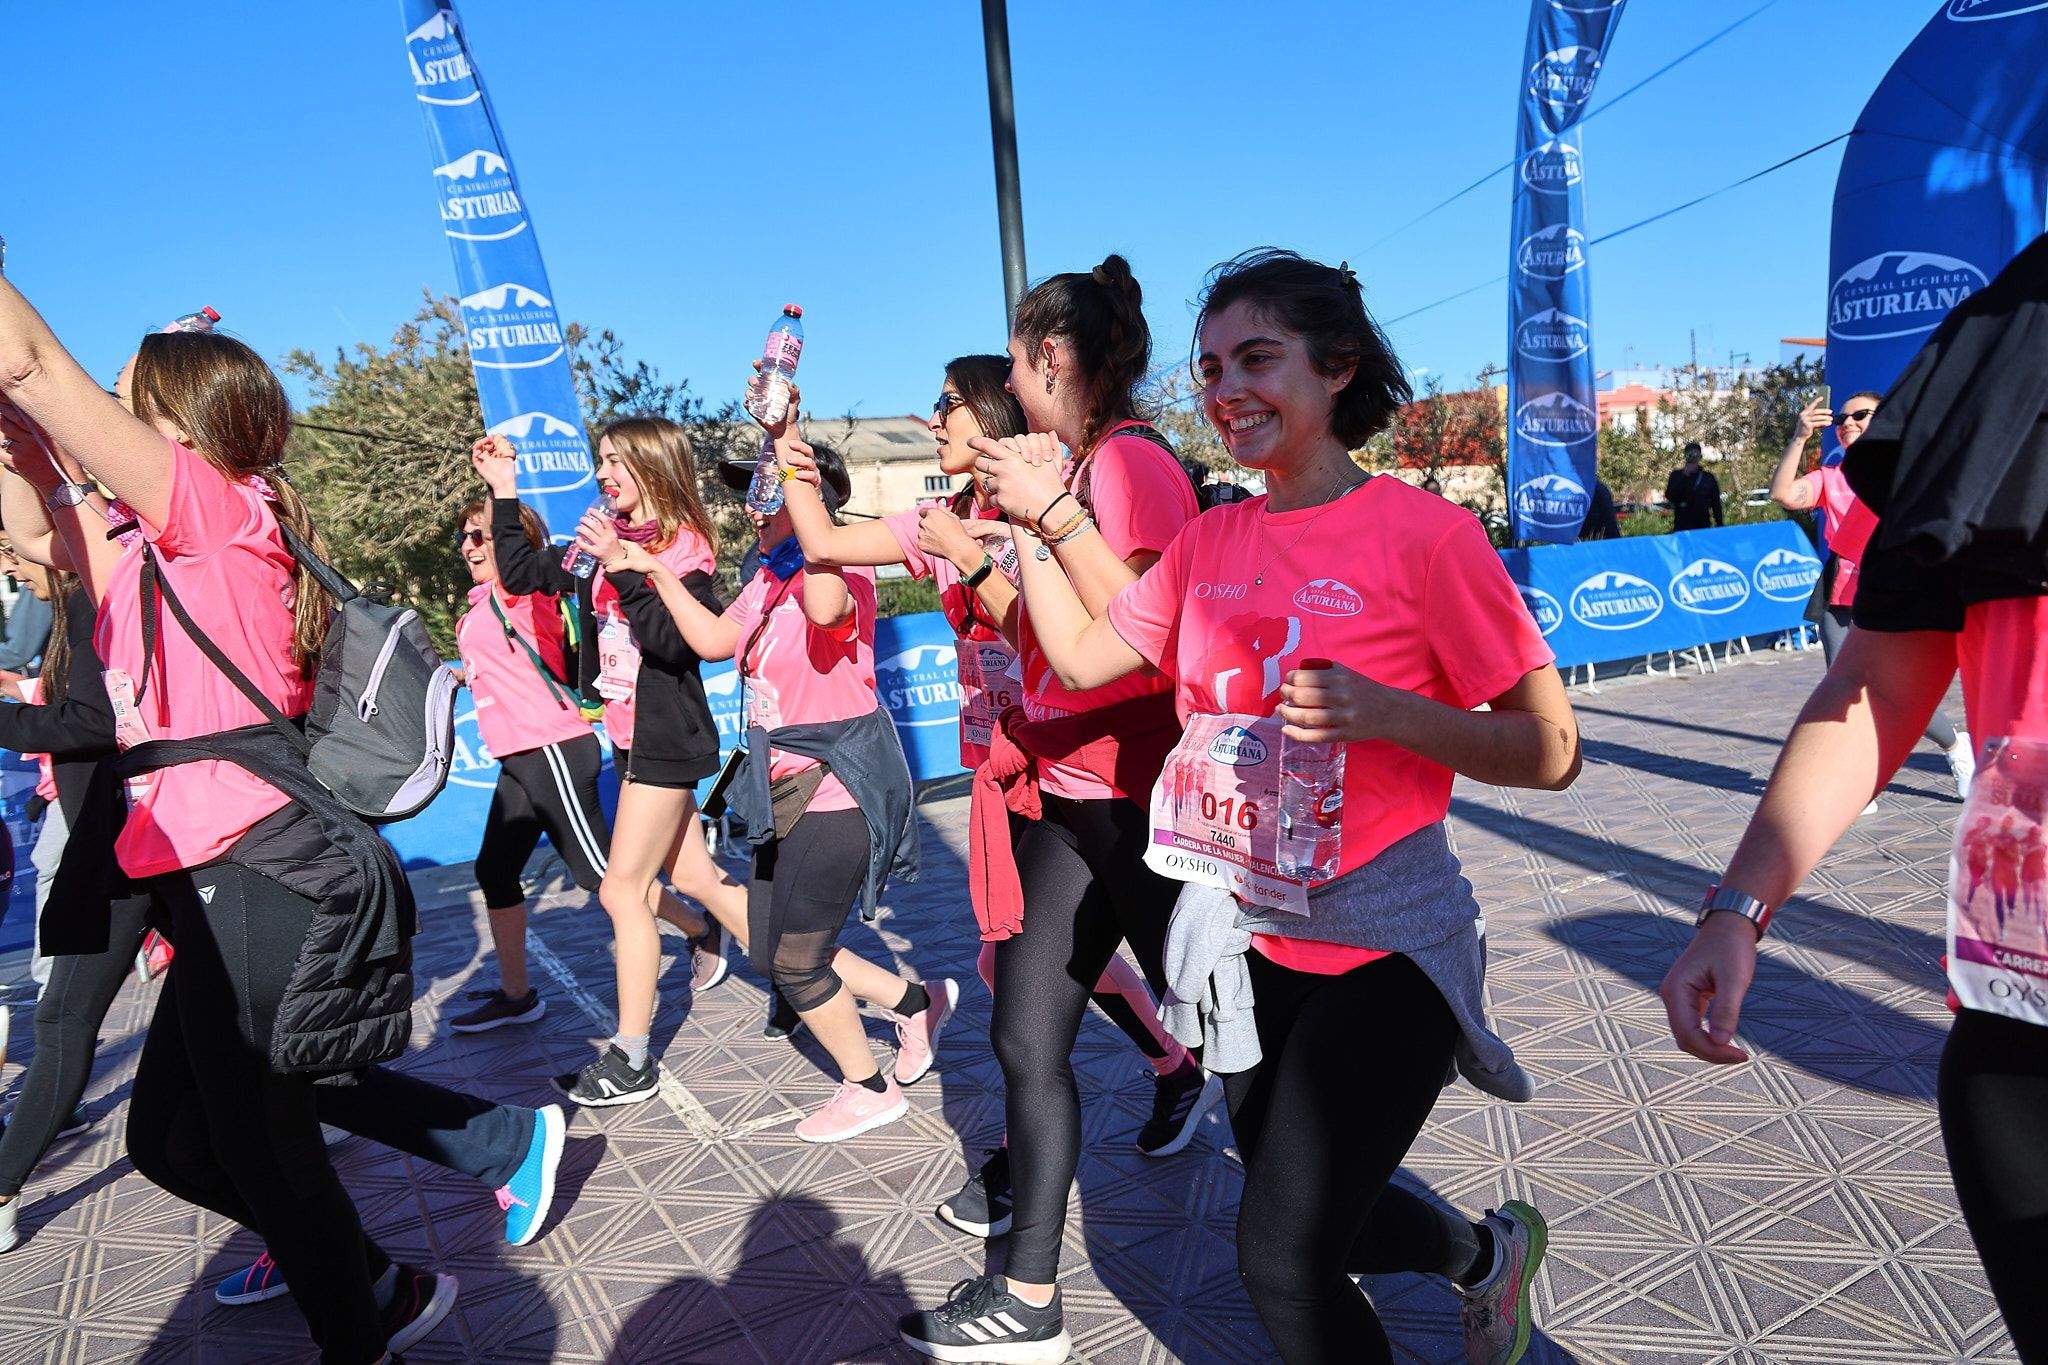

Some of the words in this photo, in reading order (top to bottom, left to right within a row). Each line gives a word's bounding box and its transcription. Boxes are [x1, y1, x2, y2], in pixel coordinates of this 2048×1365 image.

[1844, 281, 1894, 298] CENTRAL
[1901, 273, 1969, 288] LECHERA
[469, 321, 562, 351] STURIANA
[1522, 412, 1592, 434] ASTURIANA
[515, 455, 590, 478] TURIANA
[1000, 548, 1016, 570] ZERO
[1296, 590, 1356, 613] ASTURIANA
[1679, 581, 1746, 605] ASTURIANA
[1580, 594, 1658, 619] ASTURIANA
[1209, 738, 1263, 761] ASTURIANA
[1201, 792, 1260, 830] 016
[1172, 835, 1202, 851] CARRERA
[1202, 843, 1213, 854] DE
[1212, 846, 1223, 857] LA
[1222, 849, 1245, 865] MUJER
[1210, 829, 1236, 849] 7440
[1165, 854, 1218, 876] OYSHO
